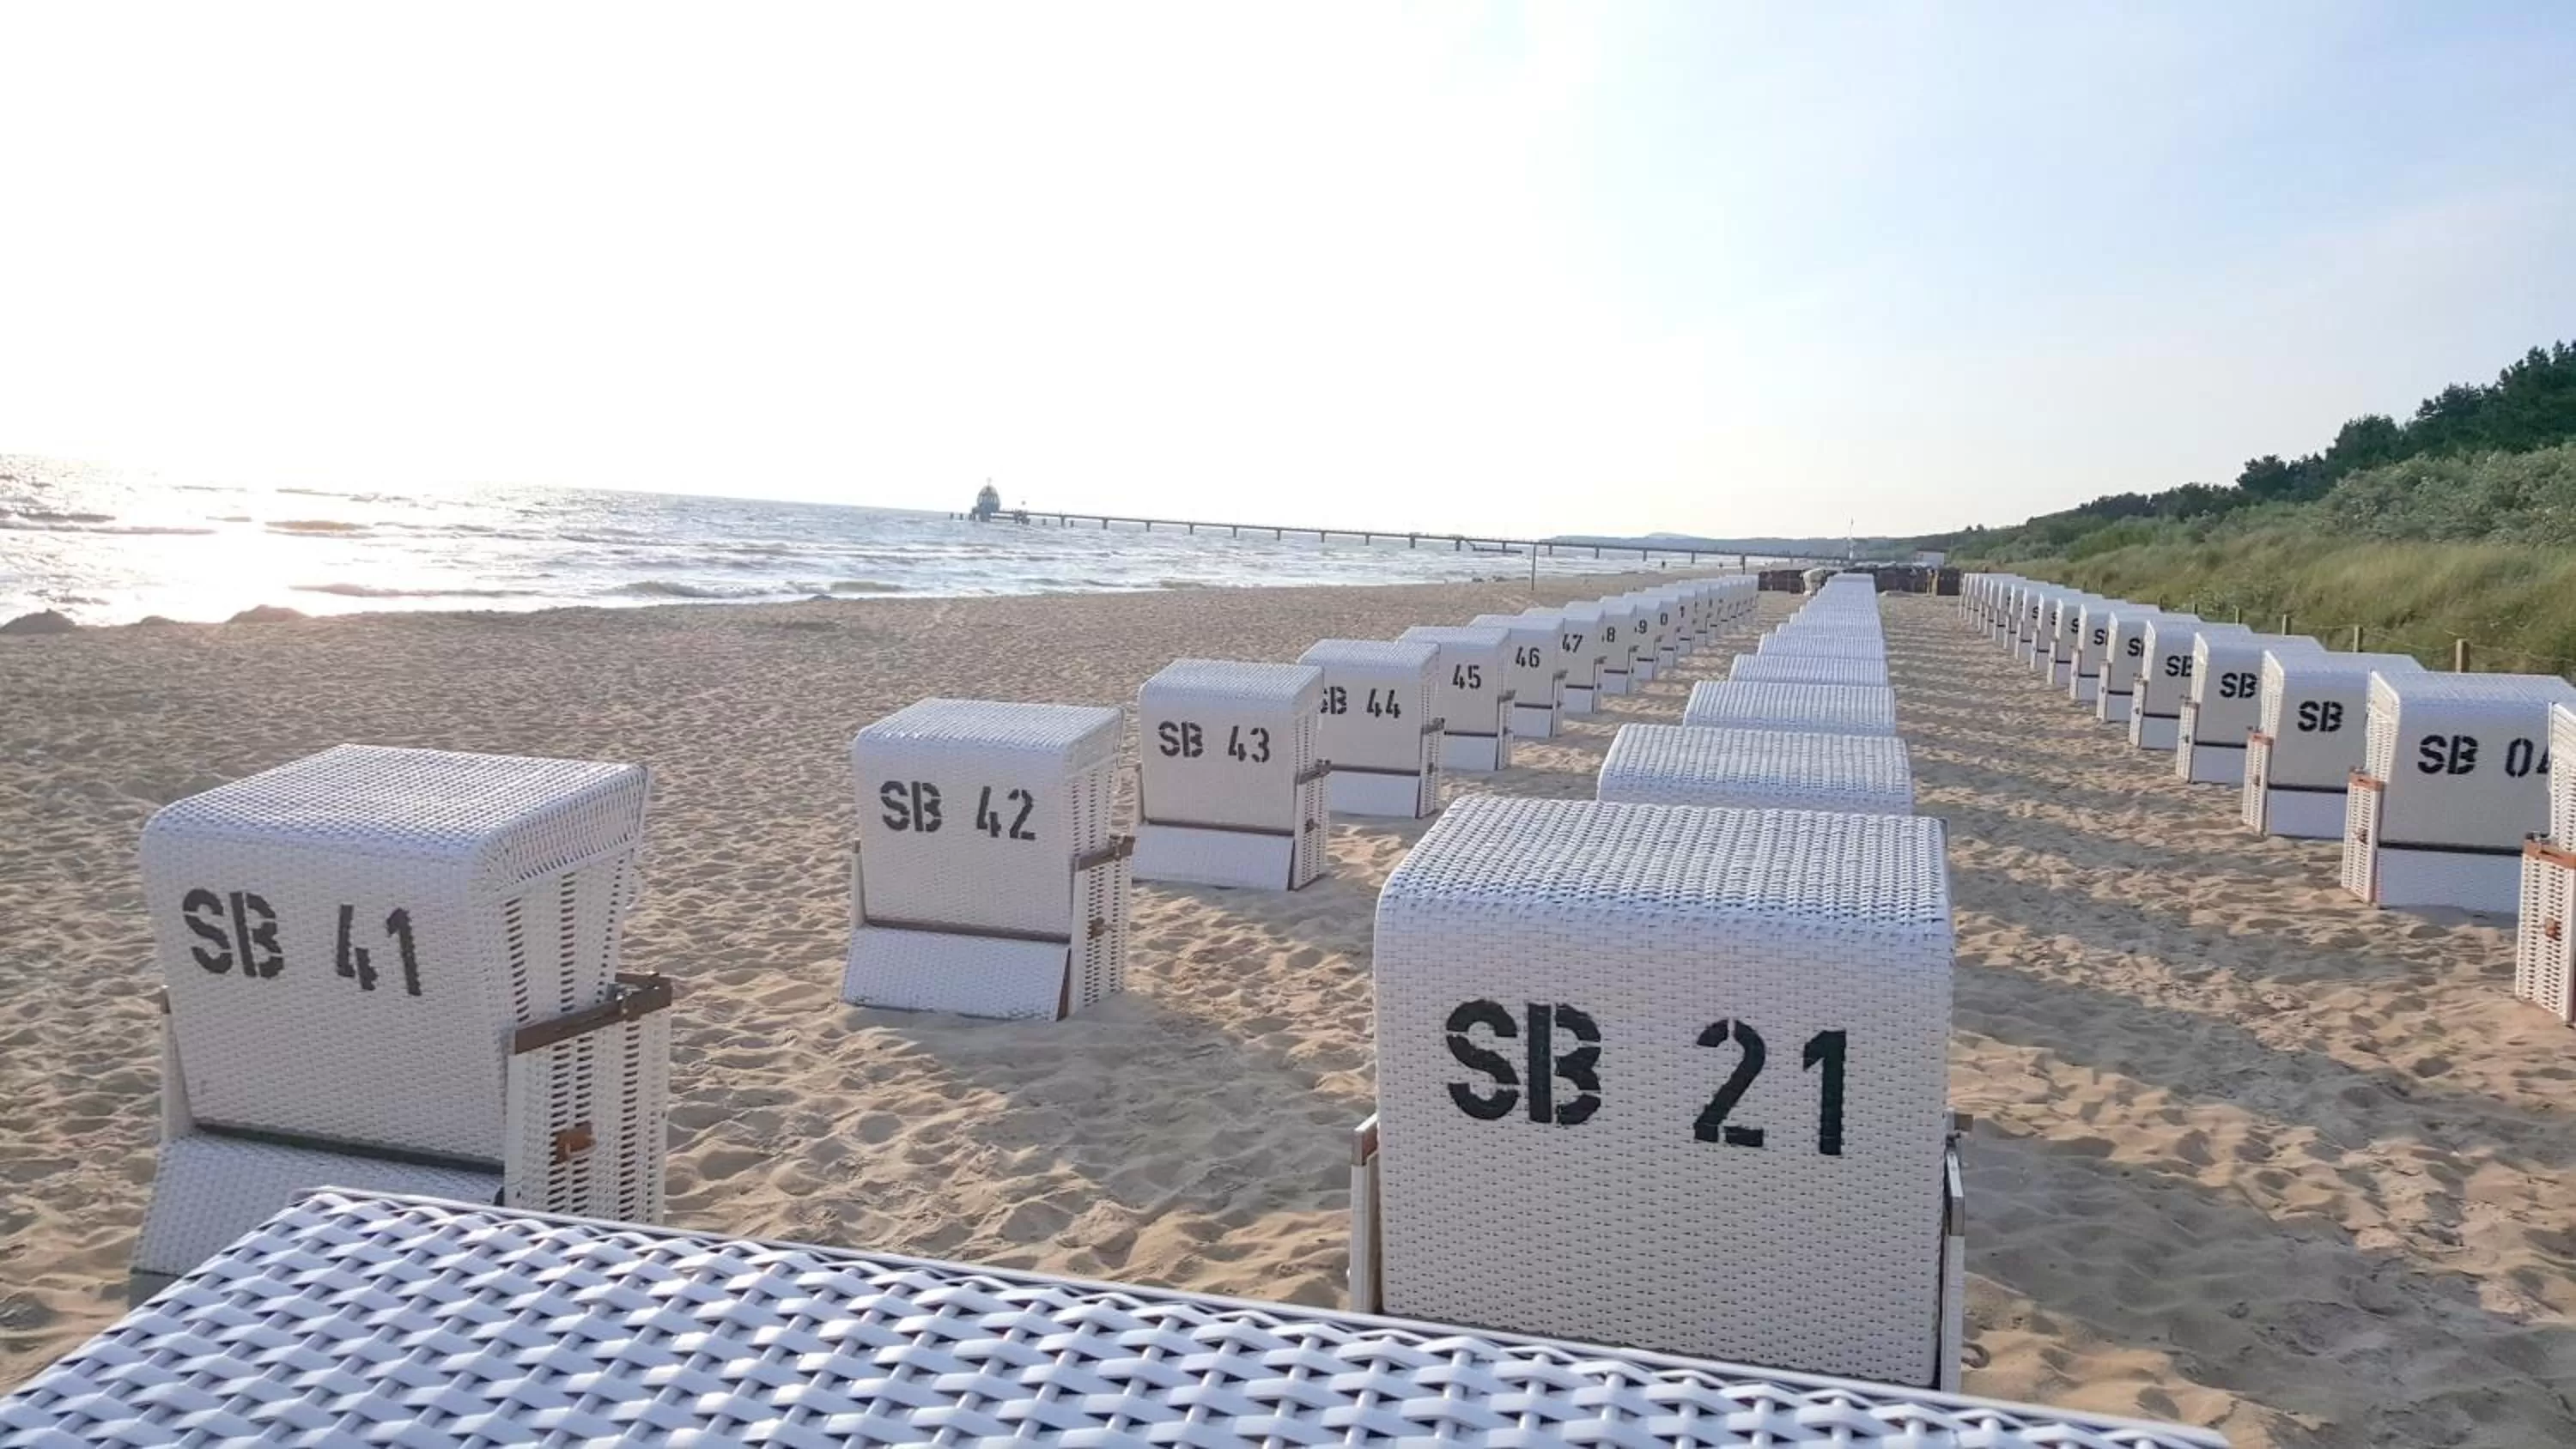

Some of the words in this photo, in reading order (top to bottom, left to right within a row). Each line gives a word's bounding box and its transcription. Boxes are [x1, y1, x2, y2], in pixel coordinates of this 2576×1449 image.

[1562, 634, 1583, 653] 47
[1601, 627, 1615, 643] 8
[2093, 627, 2109, 646] S
[2127, 637, 2145, 658] S
[1515, 646, 1540, 669] 46
[1452, 664, 1481, 689] 45
[2220, 672, 2257, 699] SB
[1366, 688, 1401, 718] 44
[2297, 700, 2343, 732] SB
[1157, 720, 1204, 758] SB
[1228, 724, 1271, 764] 43
[2417, 734, 2479, 775] SB
[879, 779, 943, 834] SB
[975, 785, 1036, 841] 42
[181, 888, 285, 979] SB
[335, 903, 422, 996] 41
[1445, 997, 1602, 1126] SB
[1692, 1017, 1848, 1156] 21
